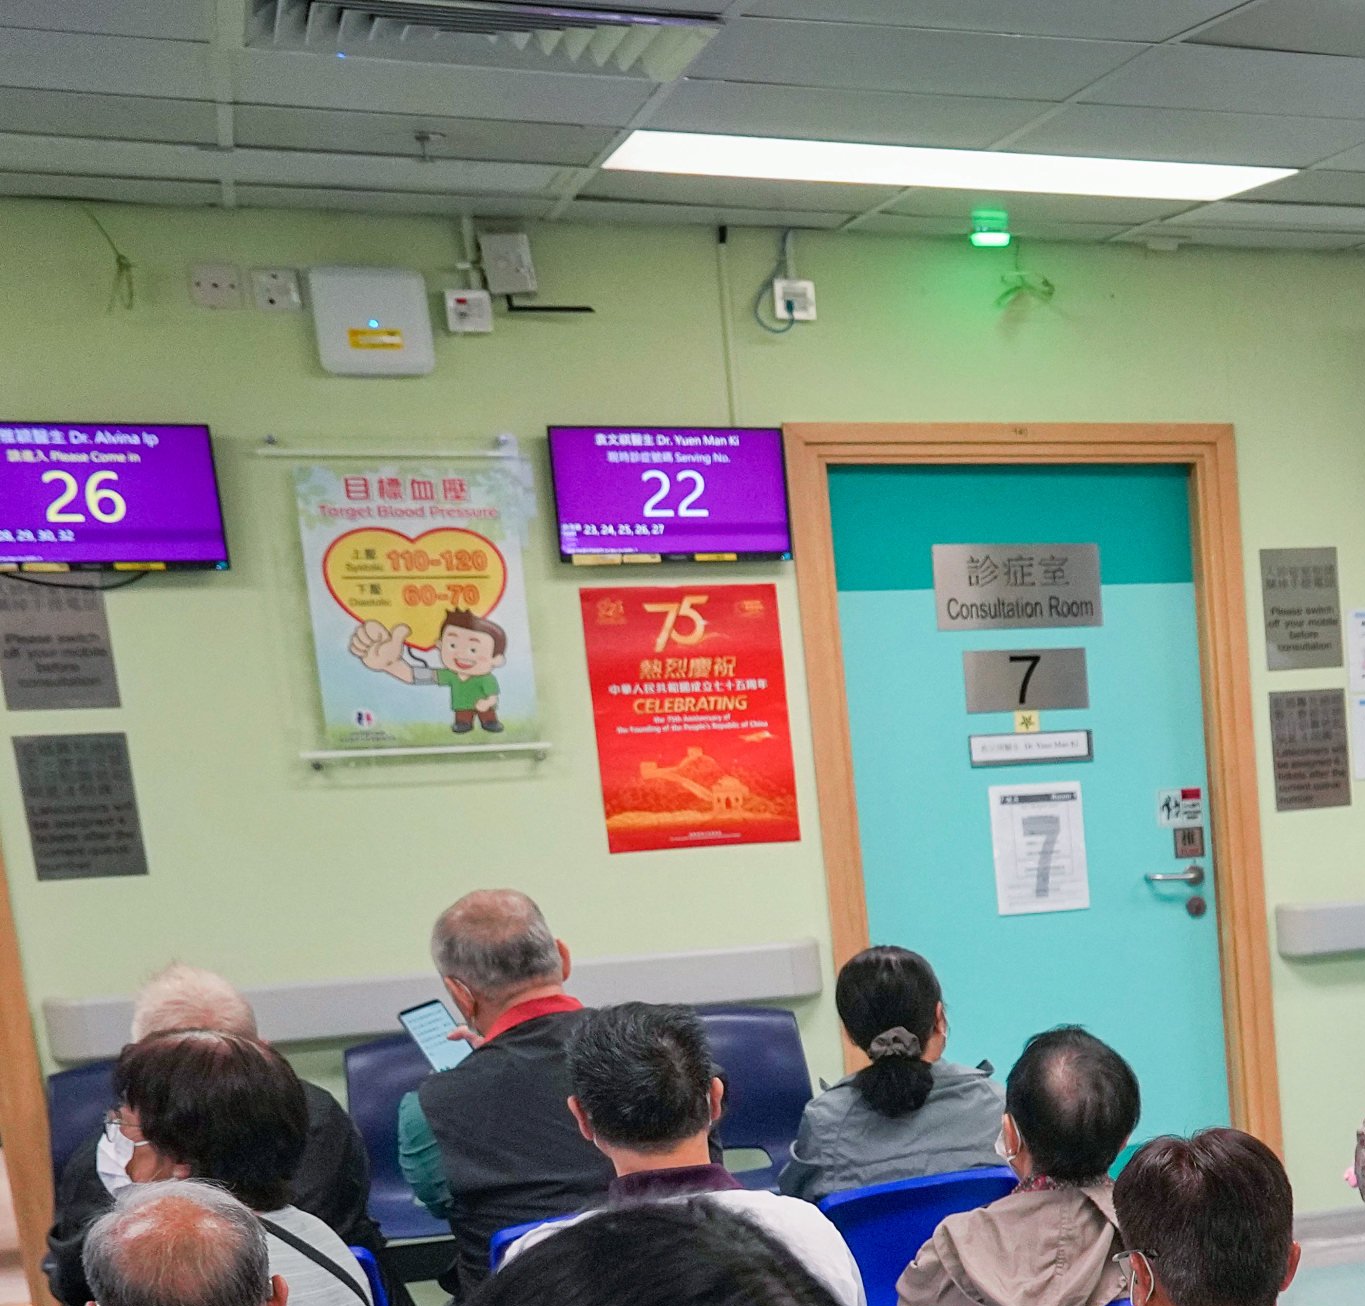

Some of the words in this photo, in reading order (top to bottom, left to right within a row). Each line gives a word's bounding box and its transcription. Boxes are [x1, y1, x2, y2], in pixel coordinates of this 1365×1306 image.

[68, 430, 92, 445] Dr.
[94, 430, 141, 445] Alvina
[655, 434, 673, 446] Dr.
[674, 434, 702, 447] Yuen
[703, 434, 727, 447] Man
[728, 434, 740, 446] Ki
[674, 451, 712, 466] Serving
[713, 452, 731, 464] No.
[41, 470, 127, 523] 26
[344, 476, 468, 501] 目標血壓
[641, 469, 710, 518] 22
[319, 505, 372, 520] Target
[377, 504, 424, 519] Blood
[430, 505, 498, 520] Pressure
[583, 523, 600, 536] 23,
[600, 523, 617, 536] 24,
[618, 523, 634, 536] 25,
[634, 523, 651, 536] 26,
[651, 523, 665, 535] 27
[386, 549, 489, 573] 110-120
[966, 554, 1070, 588] 診症室
[402, 584, 481, 606] 60-70
[946, 597, 1043, 620] Consultation
[1049, 596, 1094, 618] Room
[643, 595, 709, 653] 75
[639, 656, 736, 681] 熱烈慶祝
[1009, 655, 1041, 705] 7
[633, 694, 748, 714] CELEBRATING
[1022, 815, 1060, 898] 7
